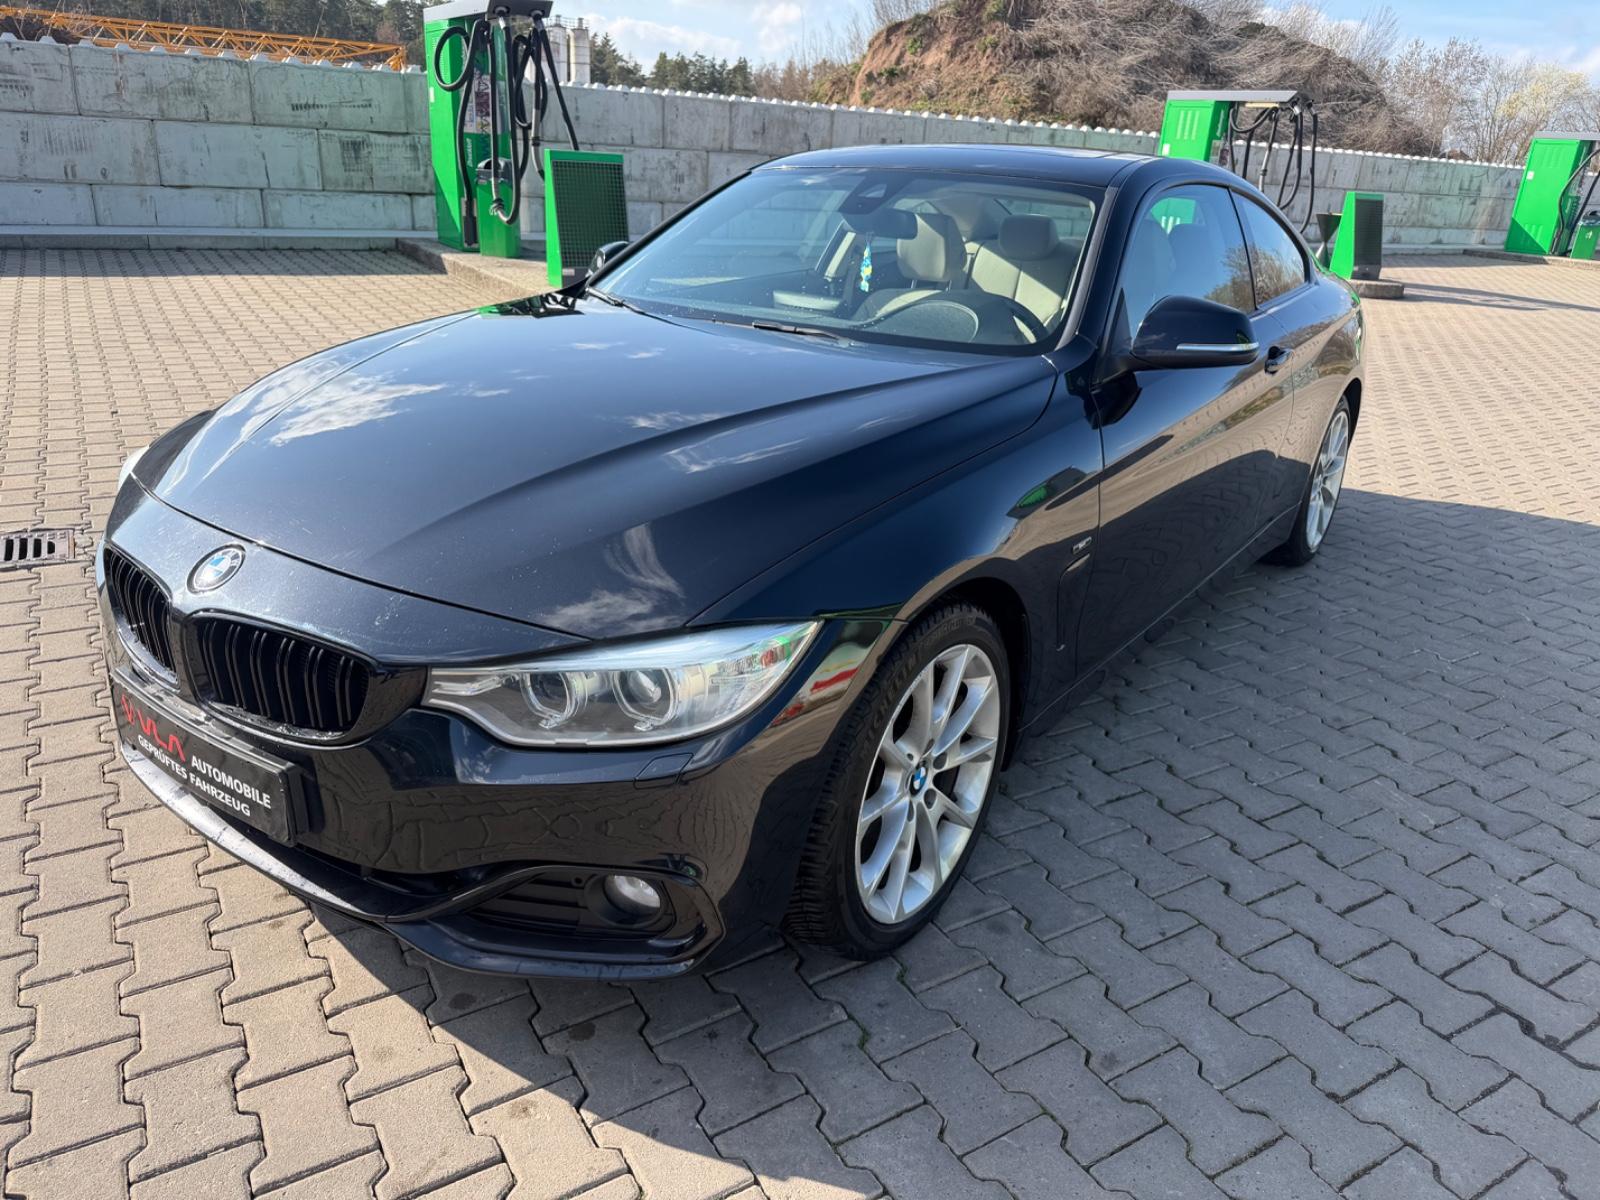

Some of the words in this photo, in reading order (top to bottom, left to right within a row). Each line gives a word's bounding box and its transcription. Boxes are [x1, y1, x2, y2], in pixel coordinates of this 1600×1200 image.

[138, 735, 187, 779] GEPRÜFTES
[189, 772, 251, 816] FAHRZEUG
[191, 755, 271, 809] AUTOMOBILE
